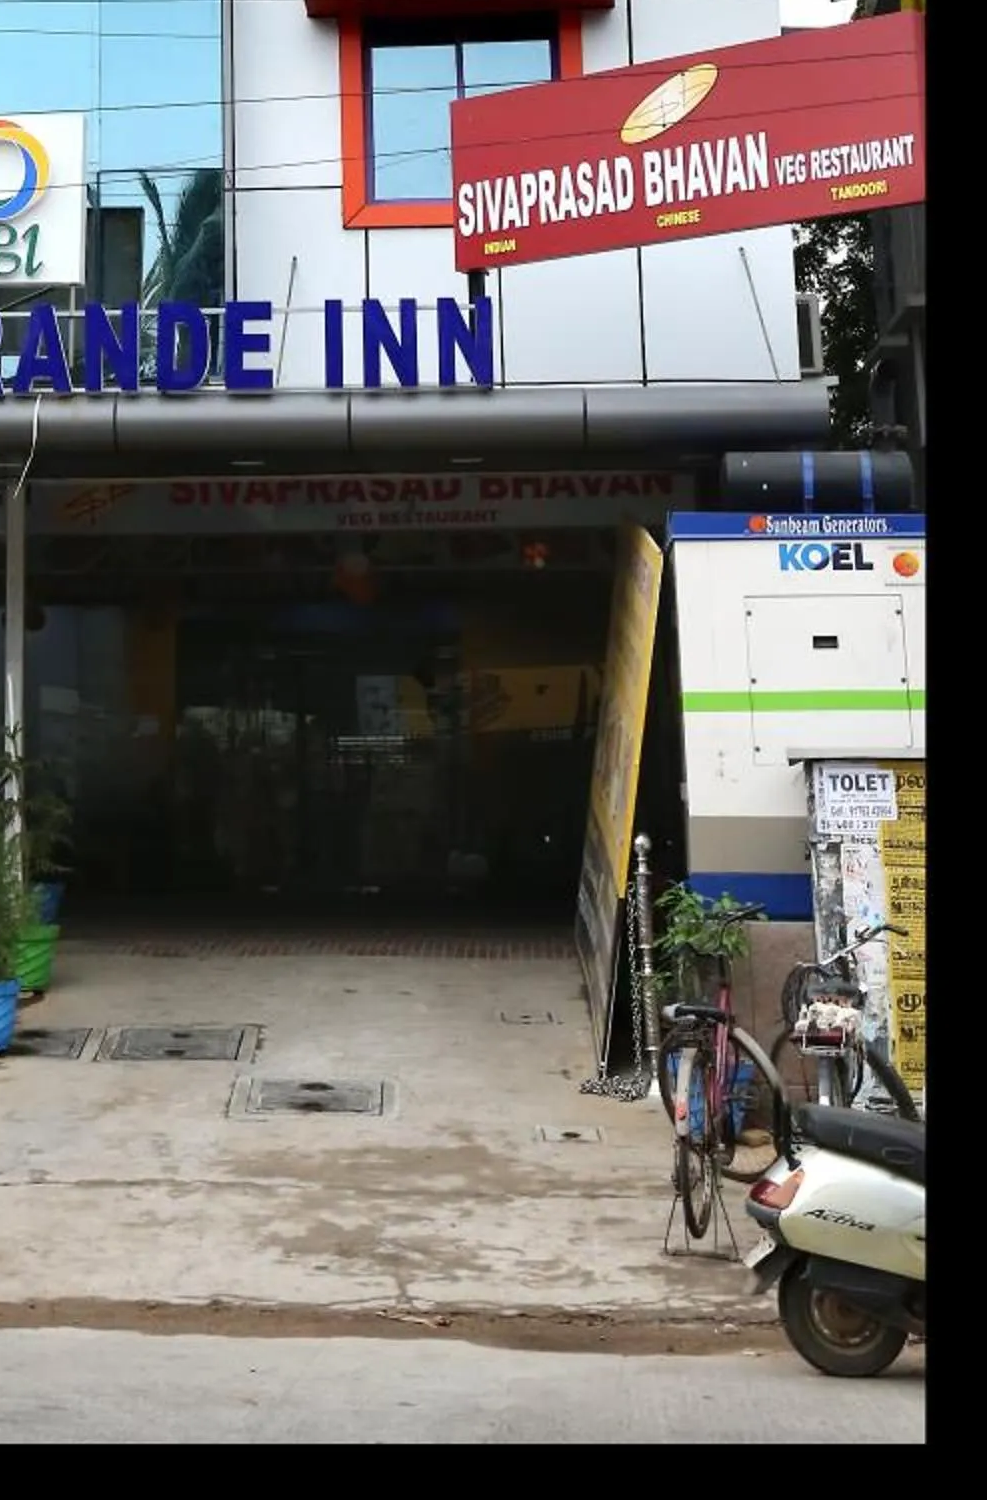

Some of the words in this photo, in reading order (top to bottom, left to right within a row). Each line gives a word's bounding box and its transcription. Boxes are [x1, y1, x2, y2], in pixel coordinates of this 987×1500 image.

[459, 156, 634, 237] SIVAPRASAD
[643, 131, 770, 207] BHAVAN
[774, 153, 807, 186] VEG
[810, 134, 915, 181] RESTAURANT
[830, 180, 888, 201] TANDOORI
[656, 209, 701, 228] CHINESE
[484, 238, 516, 255] INDIAN
[325, 296, 494, 390] INN
[766, 515, 820, 534] Sunbeam
[823, 515, 888, 533] Generators
[778, 543, 874, 571] KOEL
[803, 1208, 876, 1232] Activa
